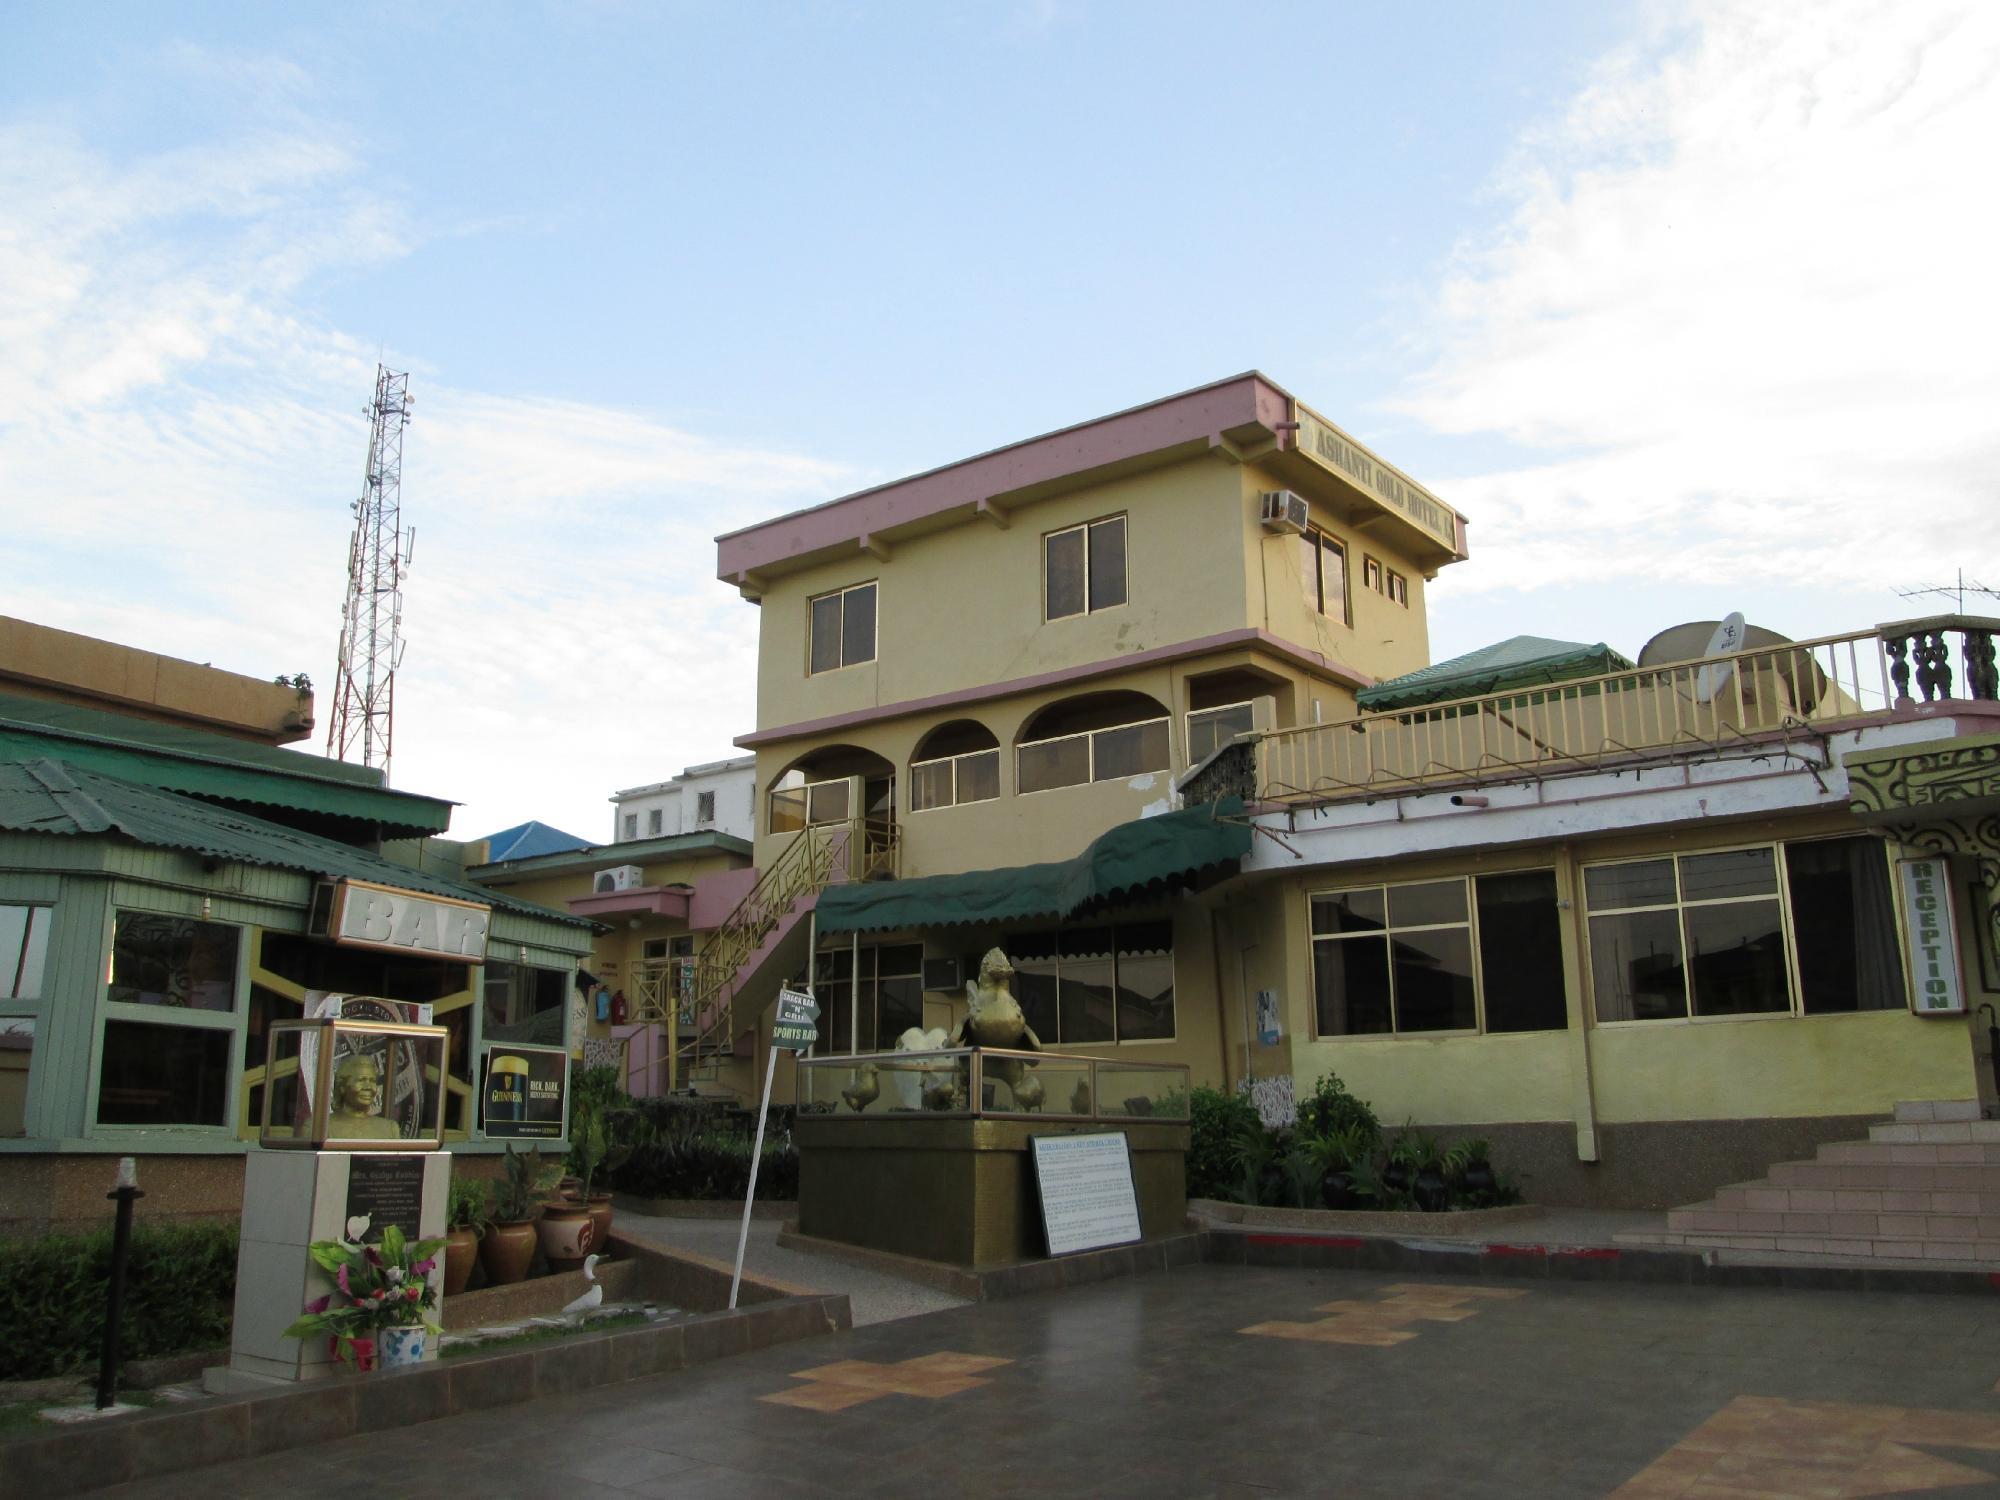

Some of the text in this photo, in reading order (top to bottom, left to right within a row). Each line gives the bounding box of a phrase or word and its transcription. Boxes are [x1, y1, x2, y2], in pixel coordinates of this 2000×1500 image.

[1317, 429, 1372, 488] ASHANTI
[1376, 469, 1404, 508] GOLD
[1407, 490, 1442, 536] HOTEL
[347, 889, 486, 957] BAR
[1911, 863, 1949, 1009] RECEPTION
[773, 1026, 817, 1041] SPORTS BAR
[492, 1089, 523, 1103] GUINNESS
